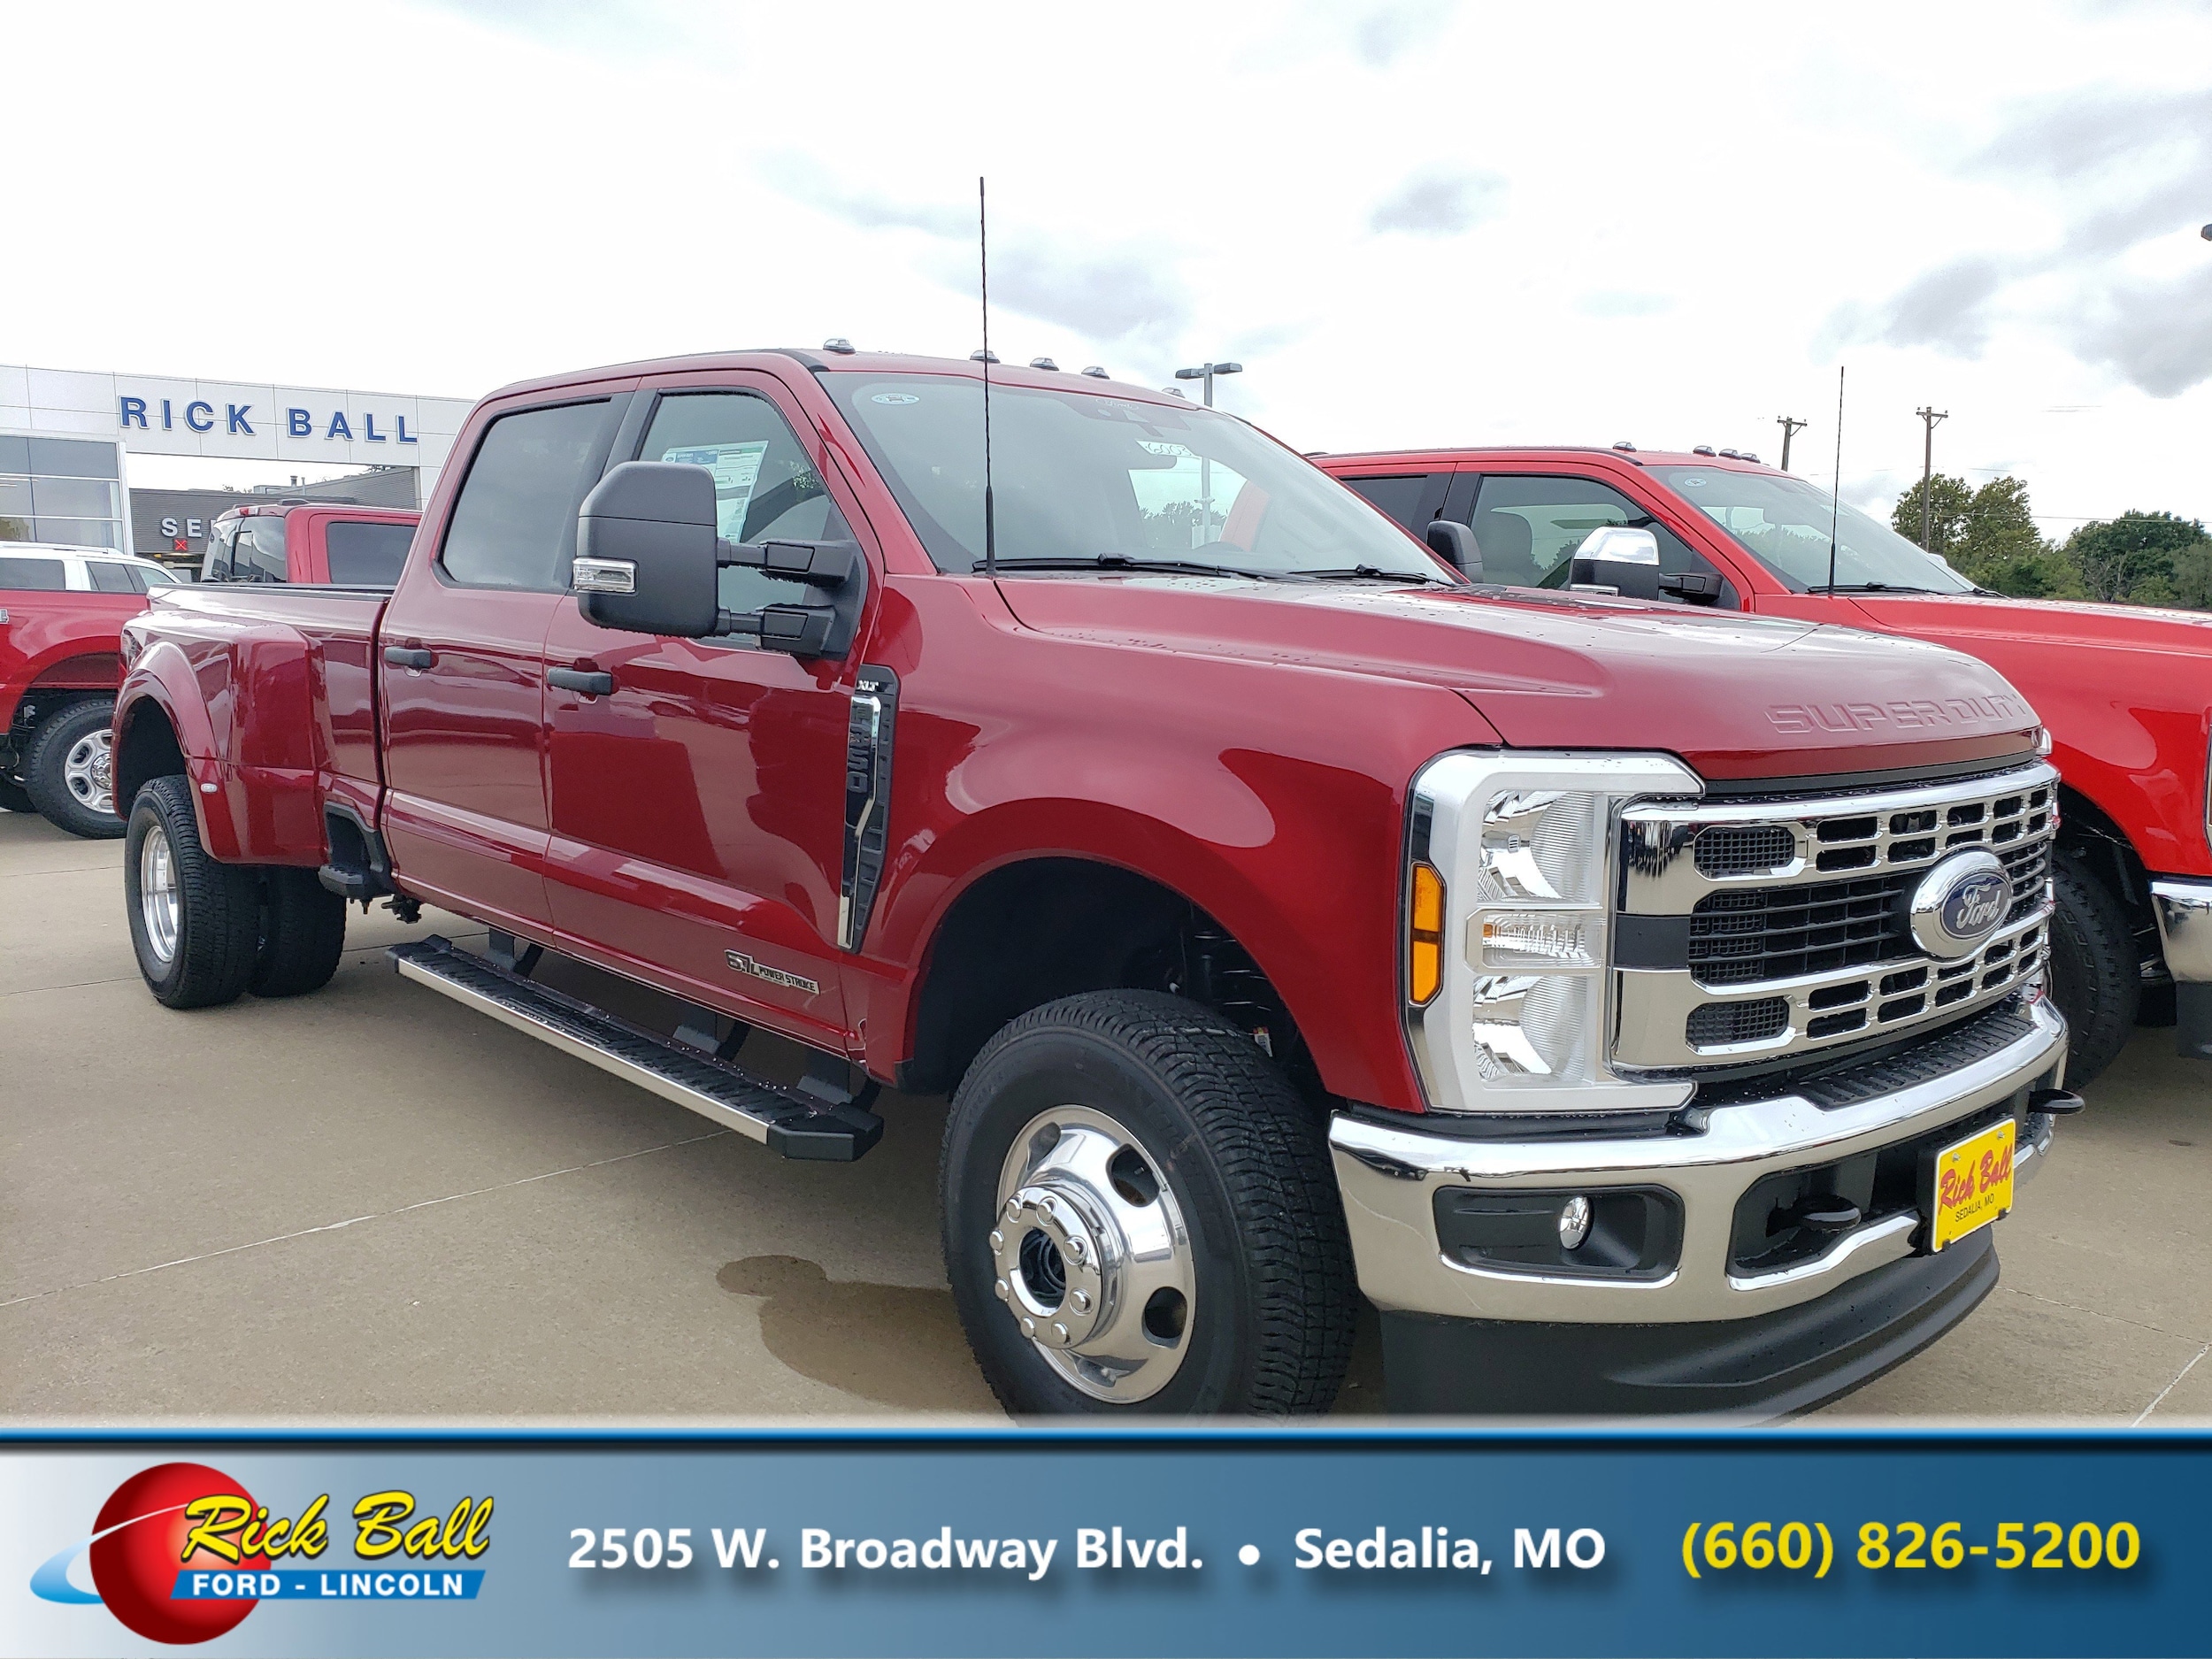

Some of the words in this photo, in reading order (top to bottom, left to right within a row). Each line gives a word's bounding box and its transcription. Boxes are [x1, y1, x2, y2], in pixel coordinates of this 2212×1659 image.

[119, 396, 254, 434] RICK
[288, 408, 418, 443] BALL
[856, 680, 879, 692] XLT
[1764, 701, 1946, 733] SUPER
[1945, 694, 2027, 725] DUTY
[1956, 883, 2001, 929] Ford
[759, 965, 785, 981] POWER
[786, 975, 816, 992] STROKE
[1939, 1161, 1975, 1215] Rick
[1980, 1143, 2013, 1194] Ball
[1985, 1193, 1995, 1207] MO
